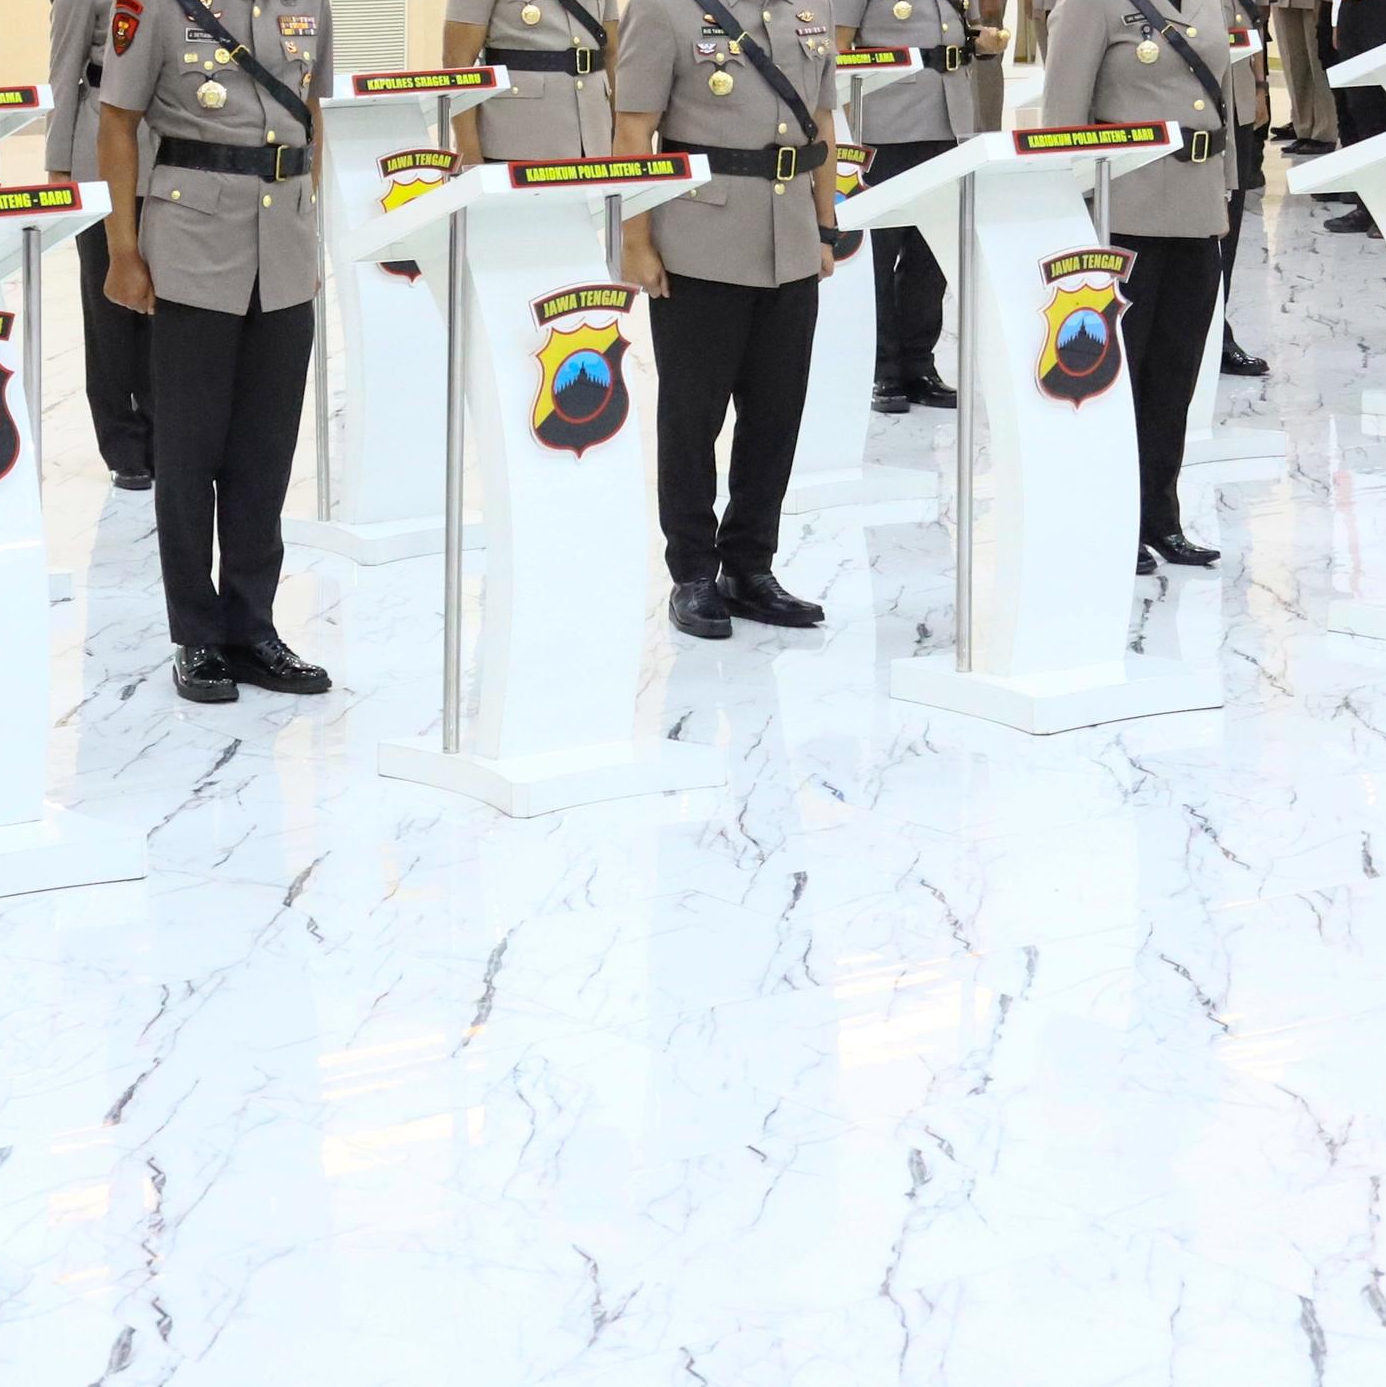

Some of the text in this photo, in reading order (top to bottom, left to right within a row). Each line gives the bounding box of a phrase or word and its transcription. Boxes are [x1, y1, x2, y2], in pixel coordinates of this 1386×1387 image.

[875, 52, 895, 62] LAMA
[367, 76, 414, 90] KAPOLRES
[414, 75, 450, 88] SRAGEN
[456, 74, 481, 84] BARU
[1028, 134, 1072, 148] KABIDKUM
[1072, 132, 1099, 144] POLDA
[1099, 130, 1127, 144] JATENG
[1132, 128, 1154, 141] BARU
[387, 153, 452, 172] JAWA TENGAH
[838, 148, 866, 163] ENGAH
[526, 167, 578, 182] KABIDKUM
[579, 164, 608, 178] POLDA
[610, 163, 642, 177] JATENG
[648, 161, 674, 174] LAMA
[39, 190, 72, 206] BARU
[1051, 254, 1123, 277] JAWA TENGAH
[543, 290, 628, 318] JAWA TENGAH
